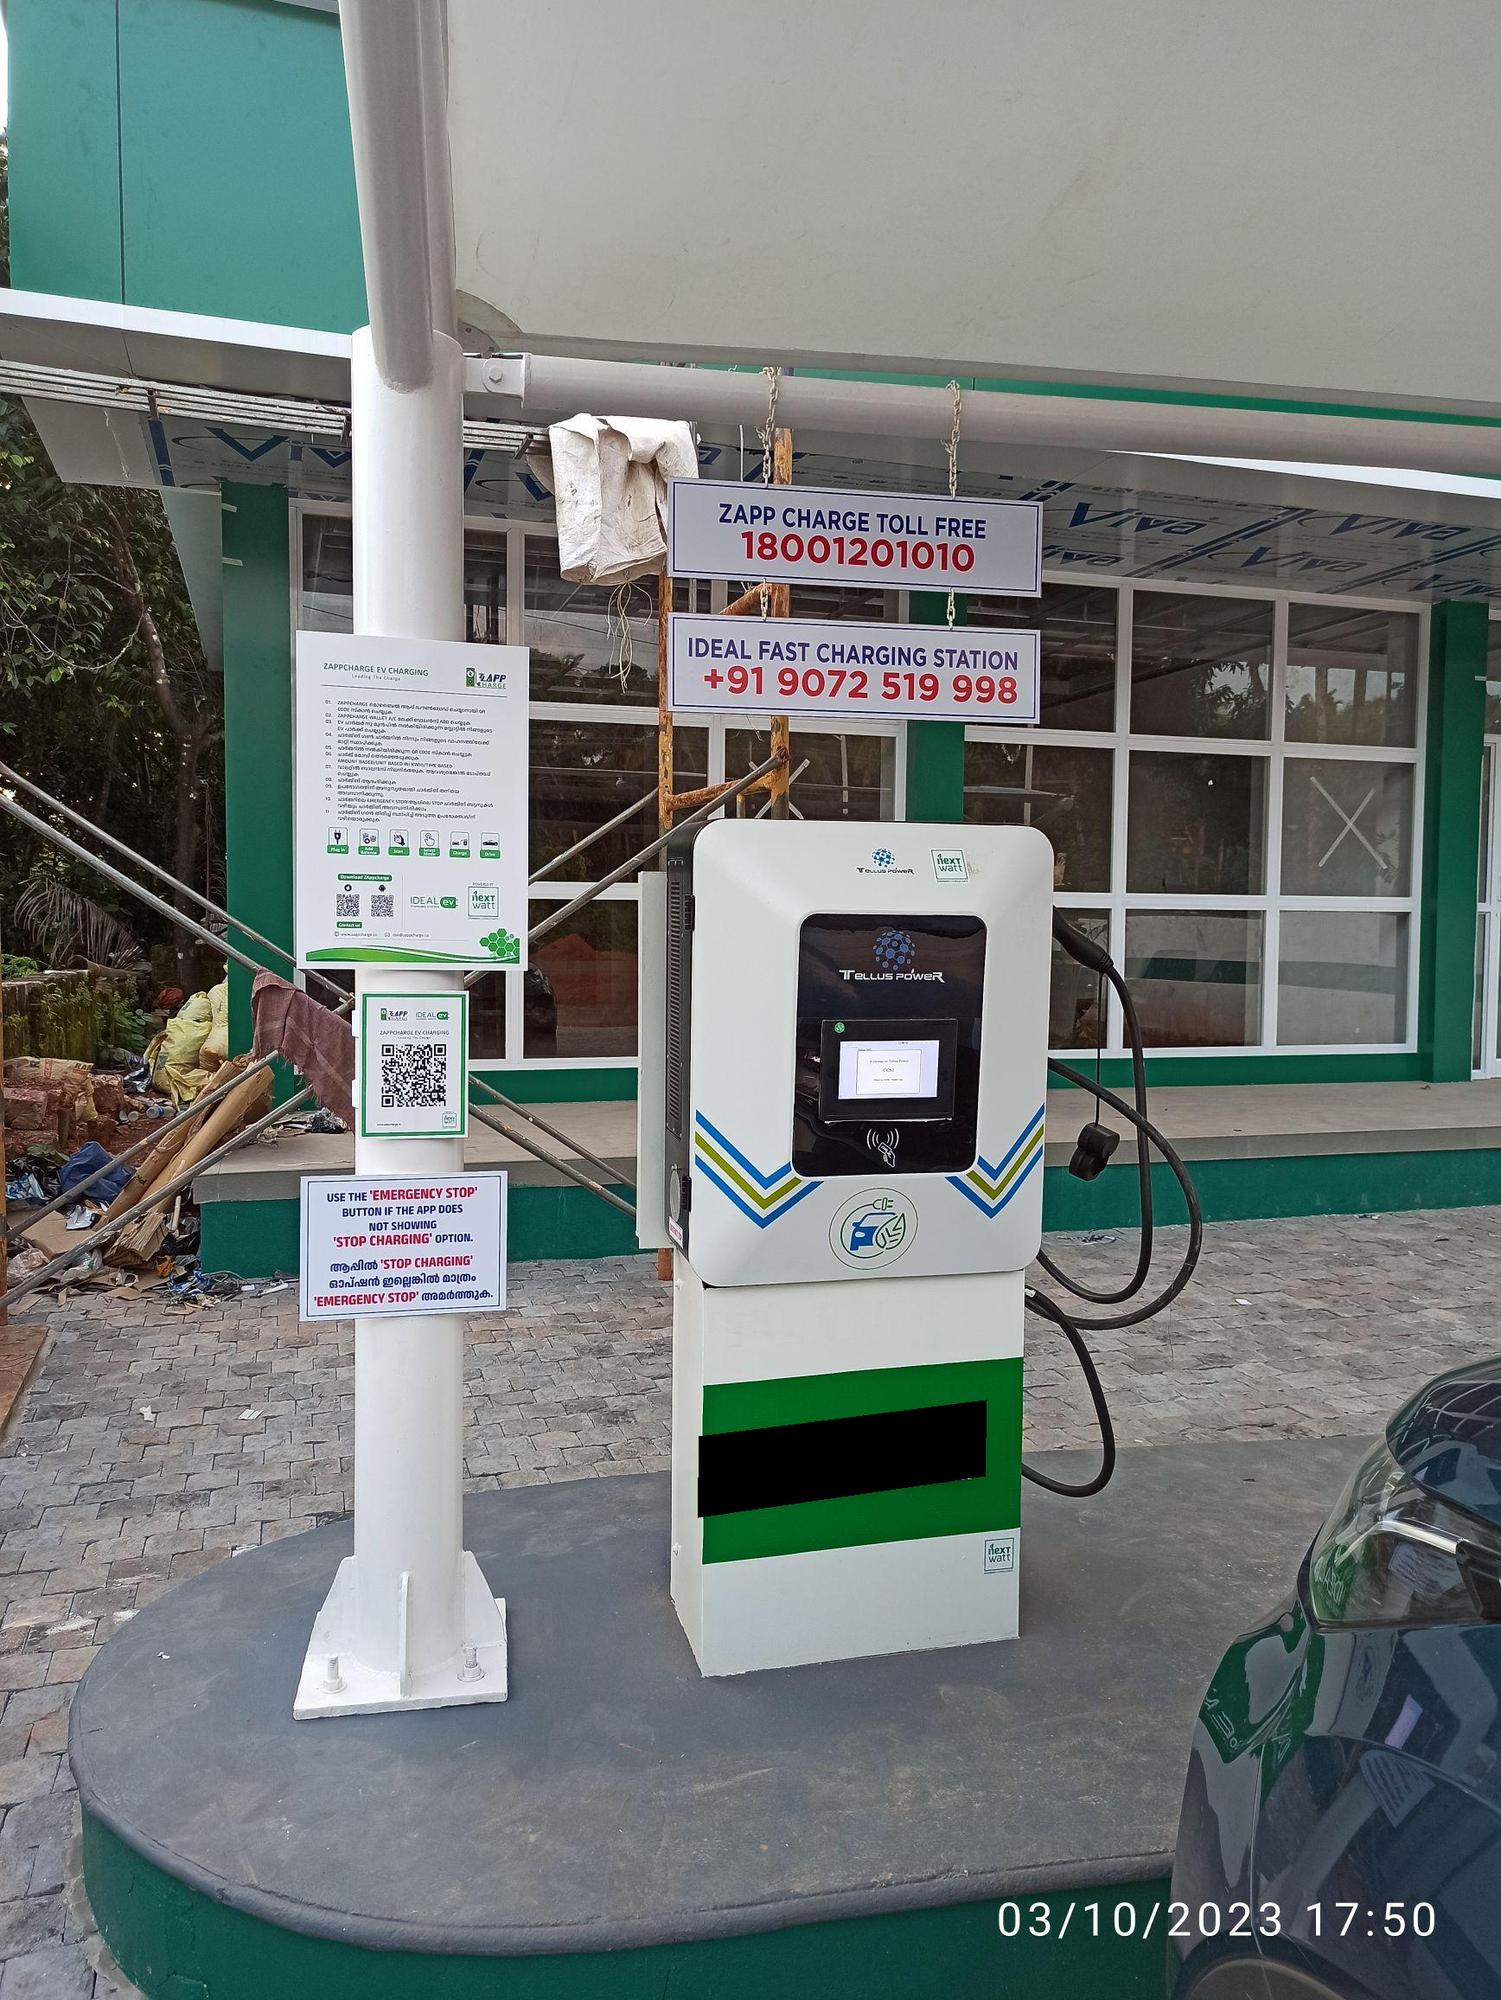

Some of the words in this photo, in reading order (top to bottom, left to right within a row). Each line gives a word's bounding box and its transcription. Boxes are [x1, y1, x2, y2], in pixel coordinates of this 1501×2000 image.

[719, 503, 776, 525] ZAPP
[782, 507, 870, 532] CHARGE
[877, 514, 928, 536] TOLL
[935, 517, 986, 539] FREE
[741, 531, 975, 573] 18001201010
[688, 637, 751, 660] IDEAL
[759, 640, 810, 662] FAST
[816, 643, 926, 667] CHARGING
[933, 648, 1018, 670] STATION
[323, 662, 375, 673] ZAPPCHARGE
[388, 667, 429, 676] CHARGING
[704, 666, 764, 695] +91
[777, 667, 869, 699] 9072
[881, 672, 939, 701] 519
[952, 675, 1018, 705] 998
[939, 864, 963, 872] watt
[327, 1193, 345, 1202] USE
[348, 1192, 367, 1201] THE
[369, 1188, 443, 1201] 'EMERGENCY
[446, 1186, 478, 1199] STOP'
[342, 1207, 382, 1217] BUTTON
[384, 1207, 393, 1216] IF
[395, 1206, 414, 1215] THE
[417, 1205, 436, 1215] APP
[438, 1204, 463, 1214] DOES
[369, 1222, 389, 1231] NOT
[391, 1220, 437, 1231] SHOWING
[333, 1235, 366, 1248] 'STOP
[369, 1233, 433, 1246] CHARGING'
[435, 1233, 473, 1244] OPTION.
[330, 1260, 378, 1274] ആപ്പിൽ
[381, 1258, 411, 1270] 'STOP
[415, 1256, 473, 1268] CHARGING'
[329, 1276, 380, 1289] ഓപ്ഷൻ
[383, 1273, 439, 1288] ഇല്ലെങ്കിൽ
[442, 1274, 476, 1285] മാത്രം
[314, 1293, 384, 1307] 'EMERGENCY
[387, 1292, 419, 1304] STOP'
[989, 1554, 1011, 1563] watt
